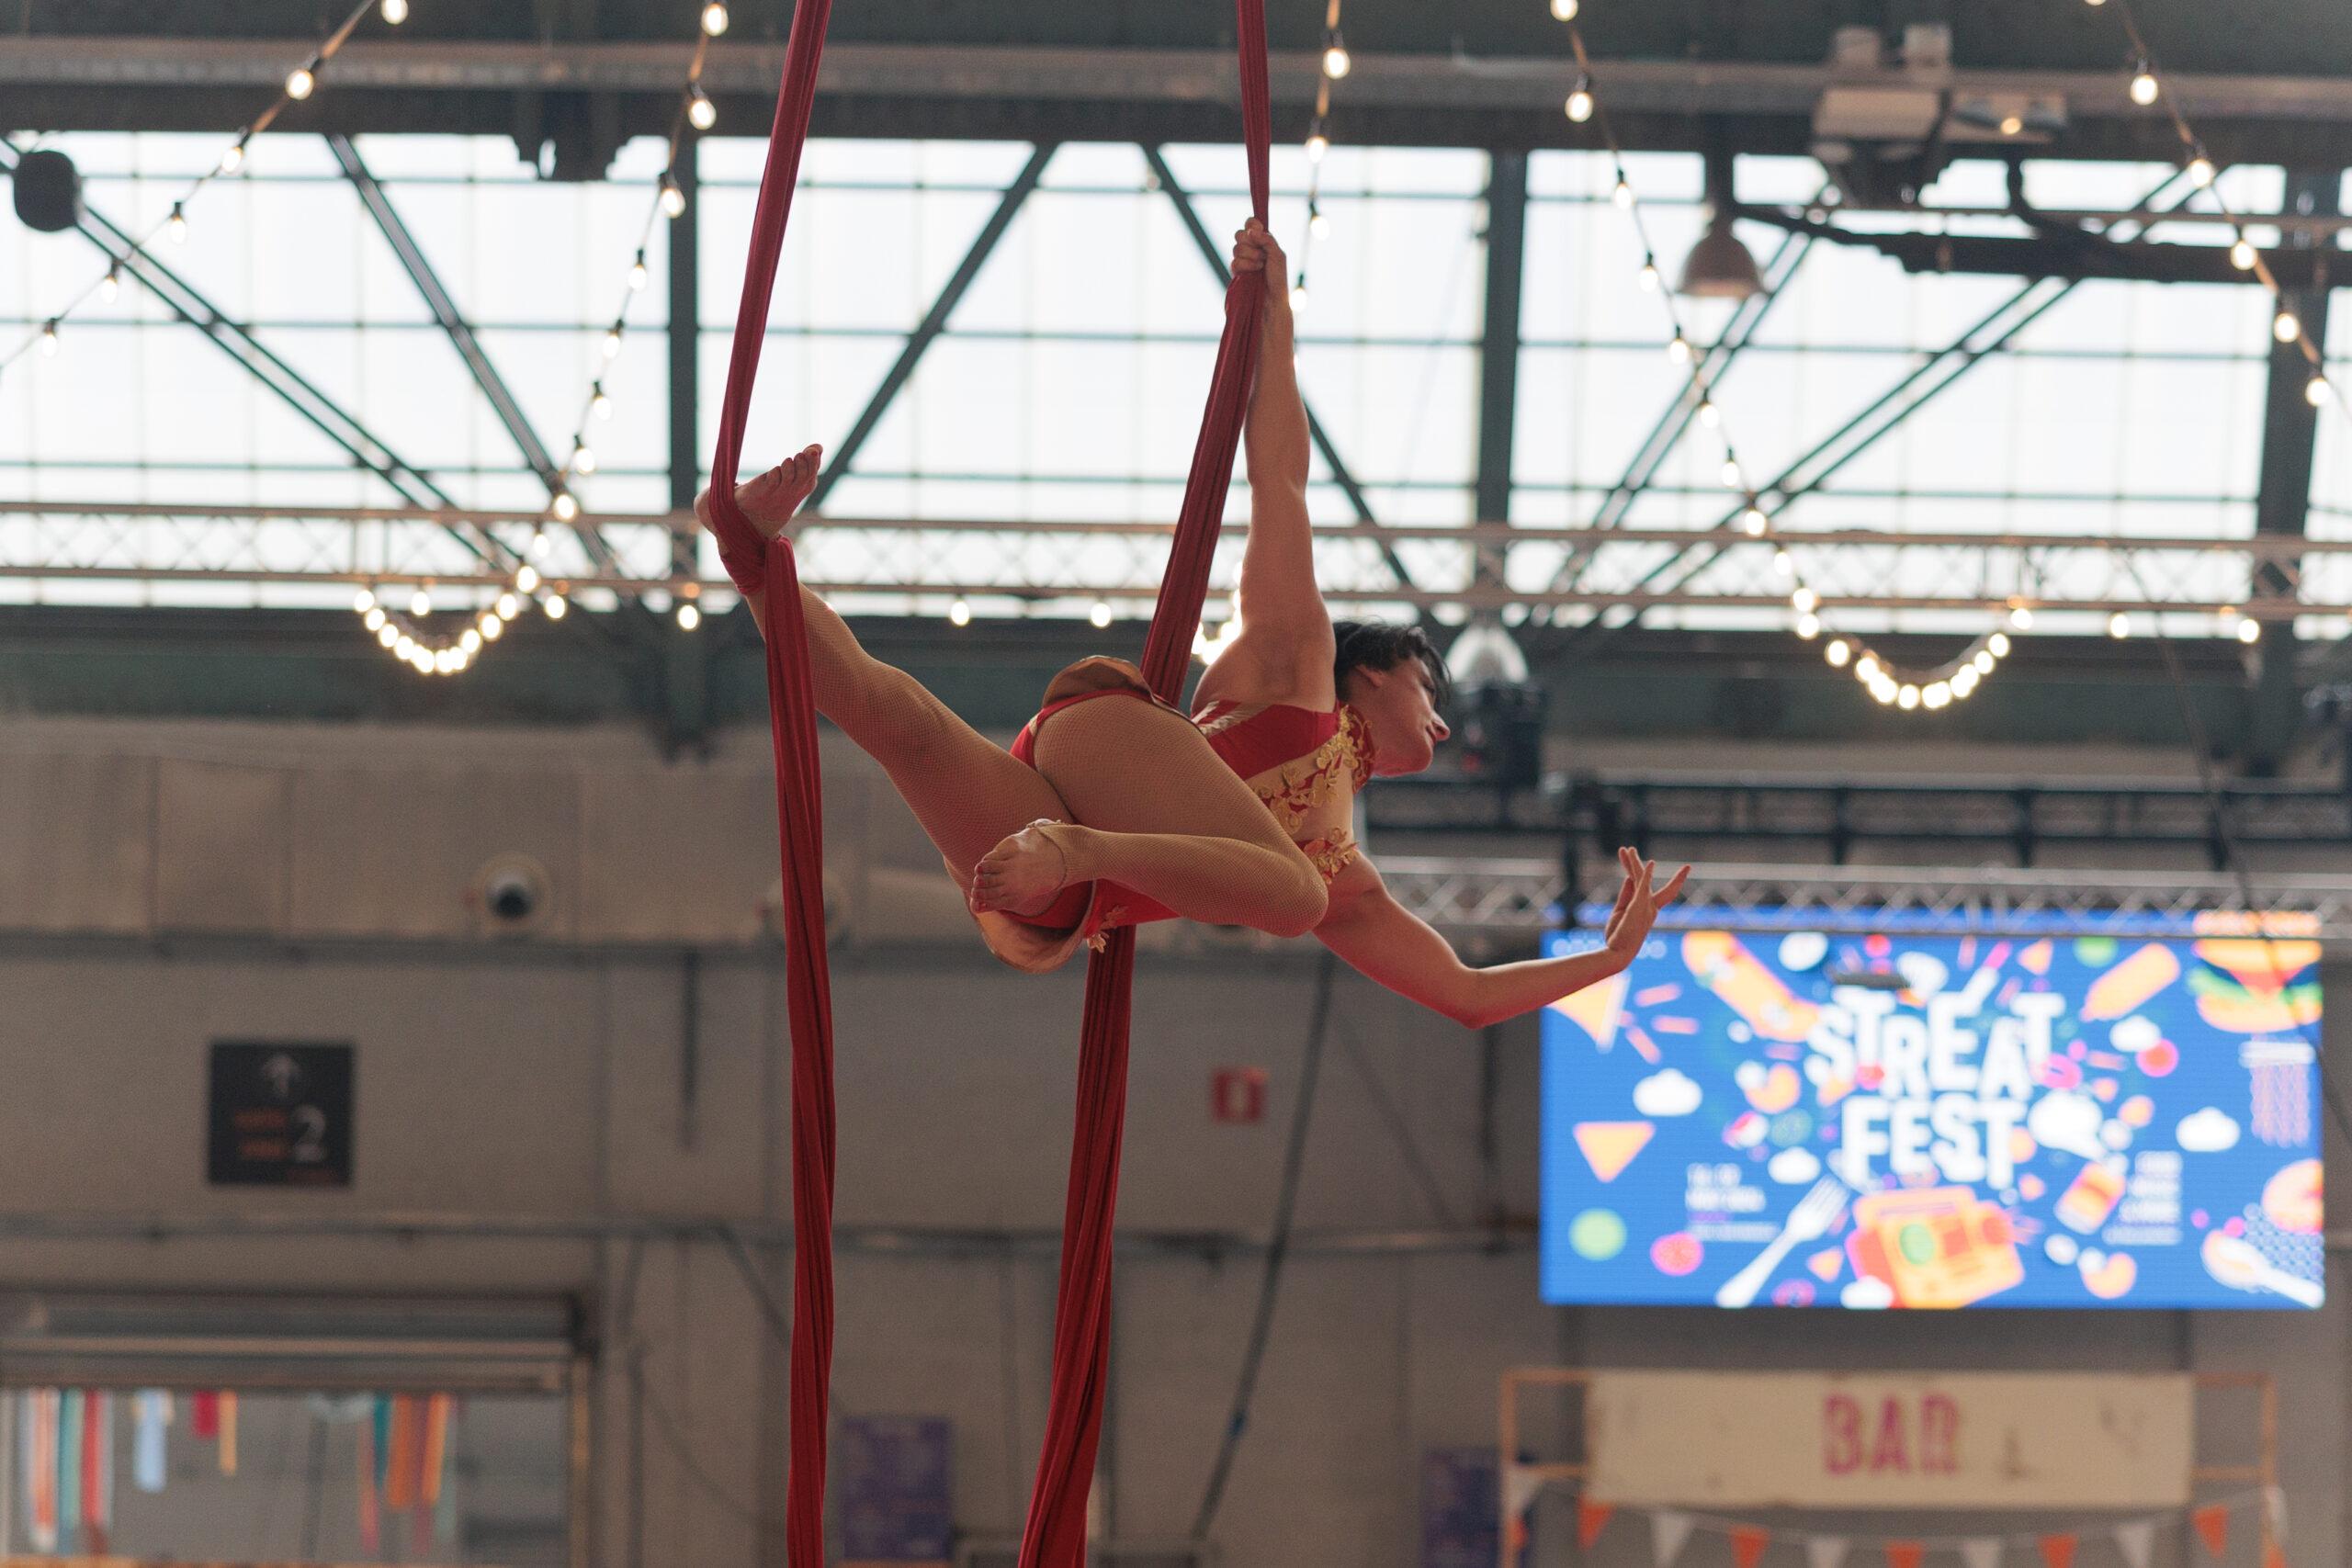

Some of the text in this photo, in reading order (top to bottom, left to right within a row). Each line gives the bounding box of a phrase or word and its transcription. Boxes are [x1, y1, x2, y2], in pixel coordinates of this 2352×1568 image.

[1804, 985, 2066, 1102] STREAT
[291, 1104, 326, 1163] 2
[1841, 1093, 2028, 1190] FEST
[1823, 1391, 1958, 1476] BAR
